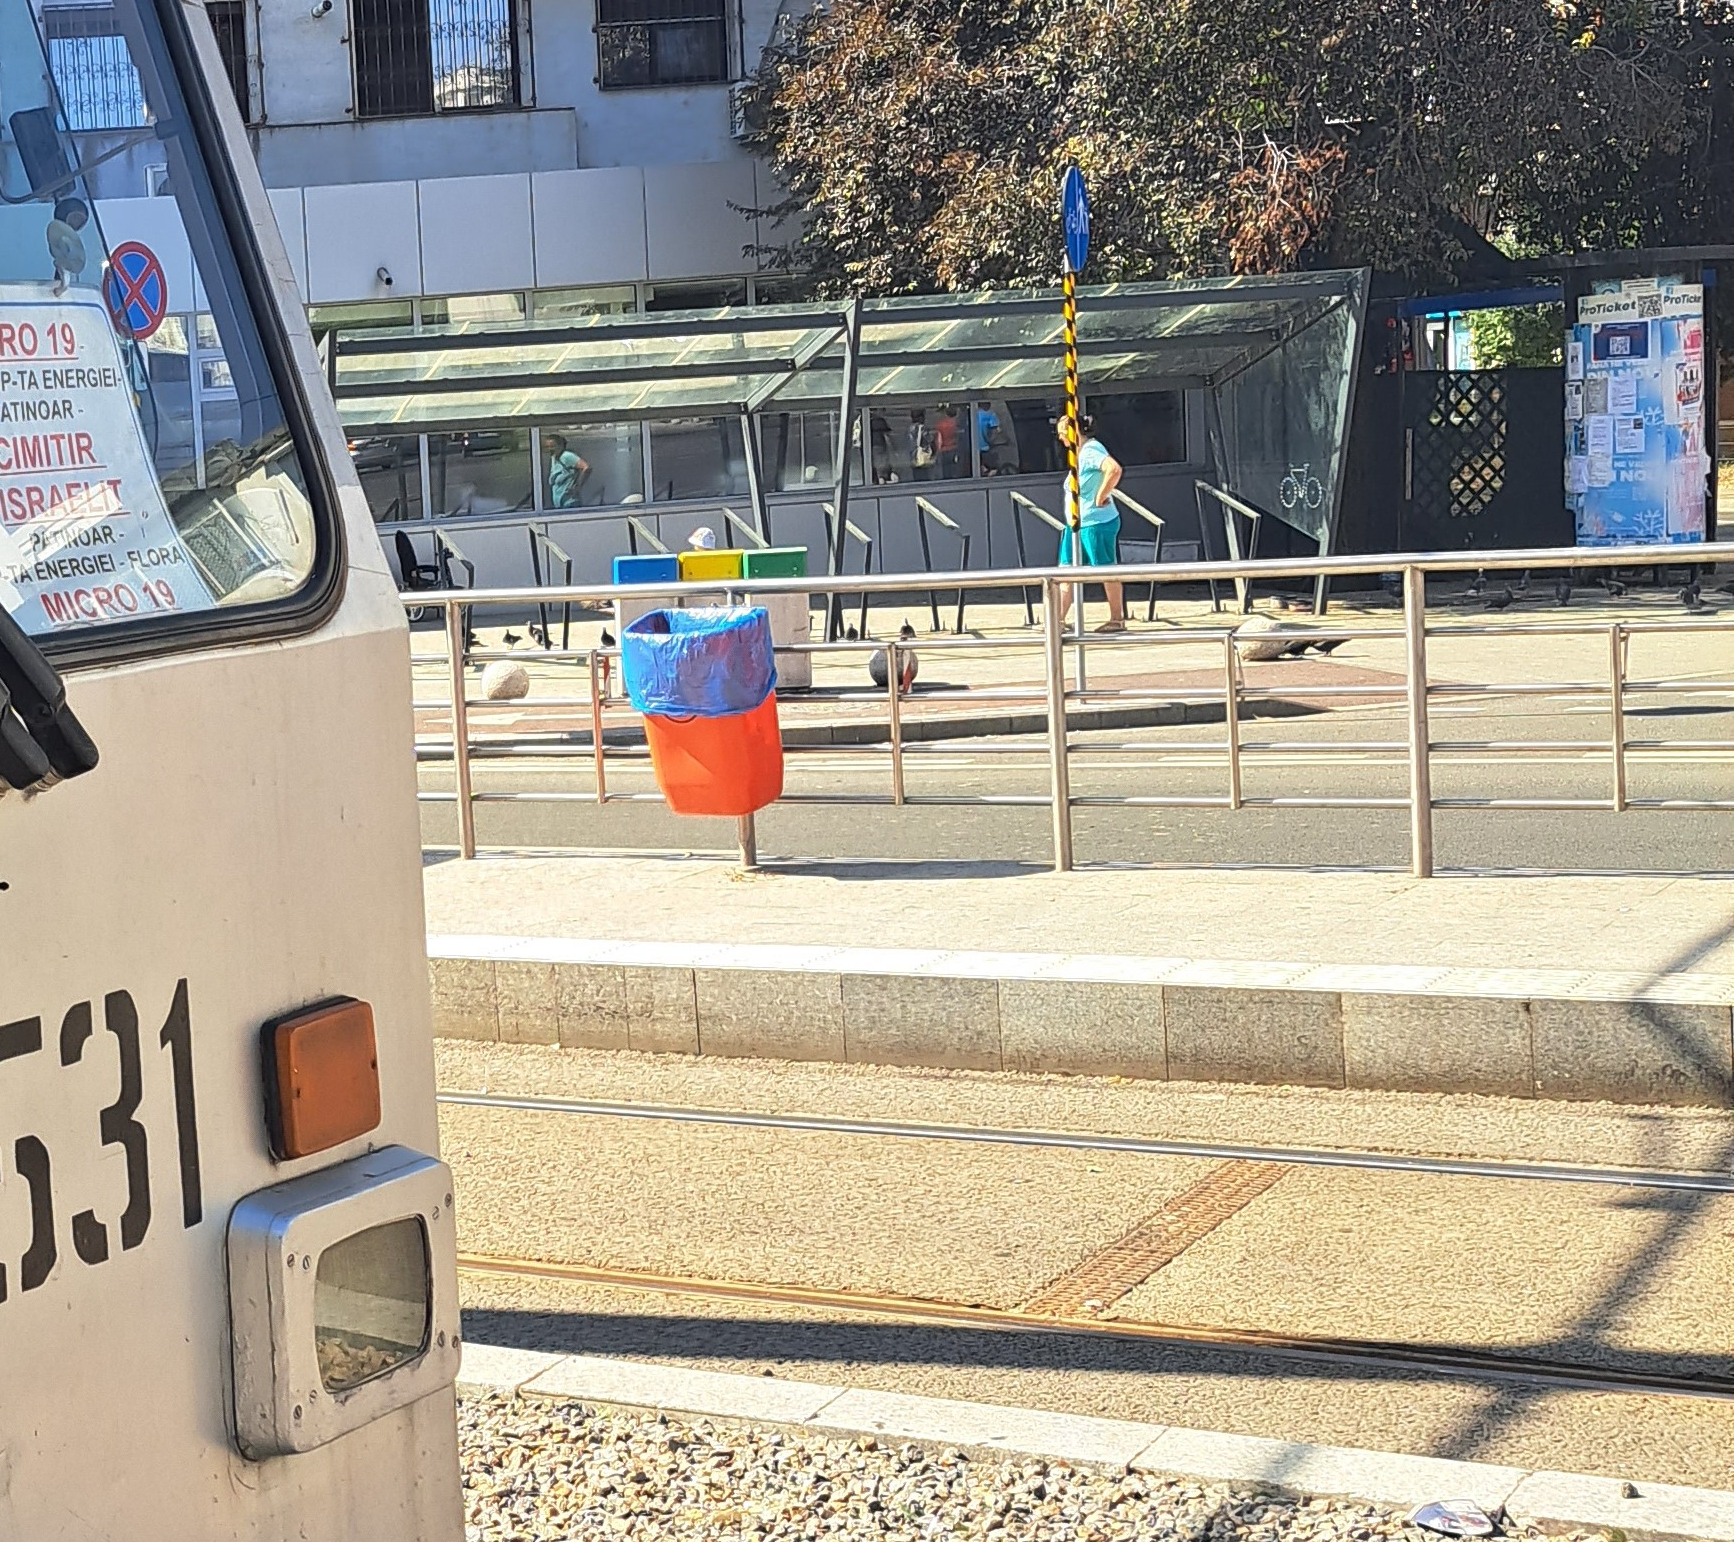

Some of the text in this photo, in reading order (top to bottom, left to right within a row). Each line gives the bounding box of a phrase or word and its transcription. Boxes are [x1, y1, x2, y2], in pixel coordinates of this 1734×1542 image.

[47, 322, 76, 356] 19
[35, 554, 116, 581] ENERGIEI
[127, 546, 184, 568] FLORA
[40, 579, 177, 623] MICRO 19
